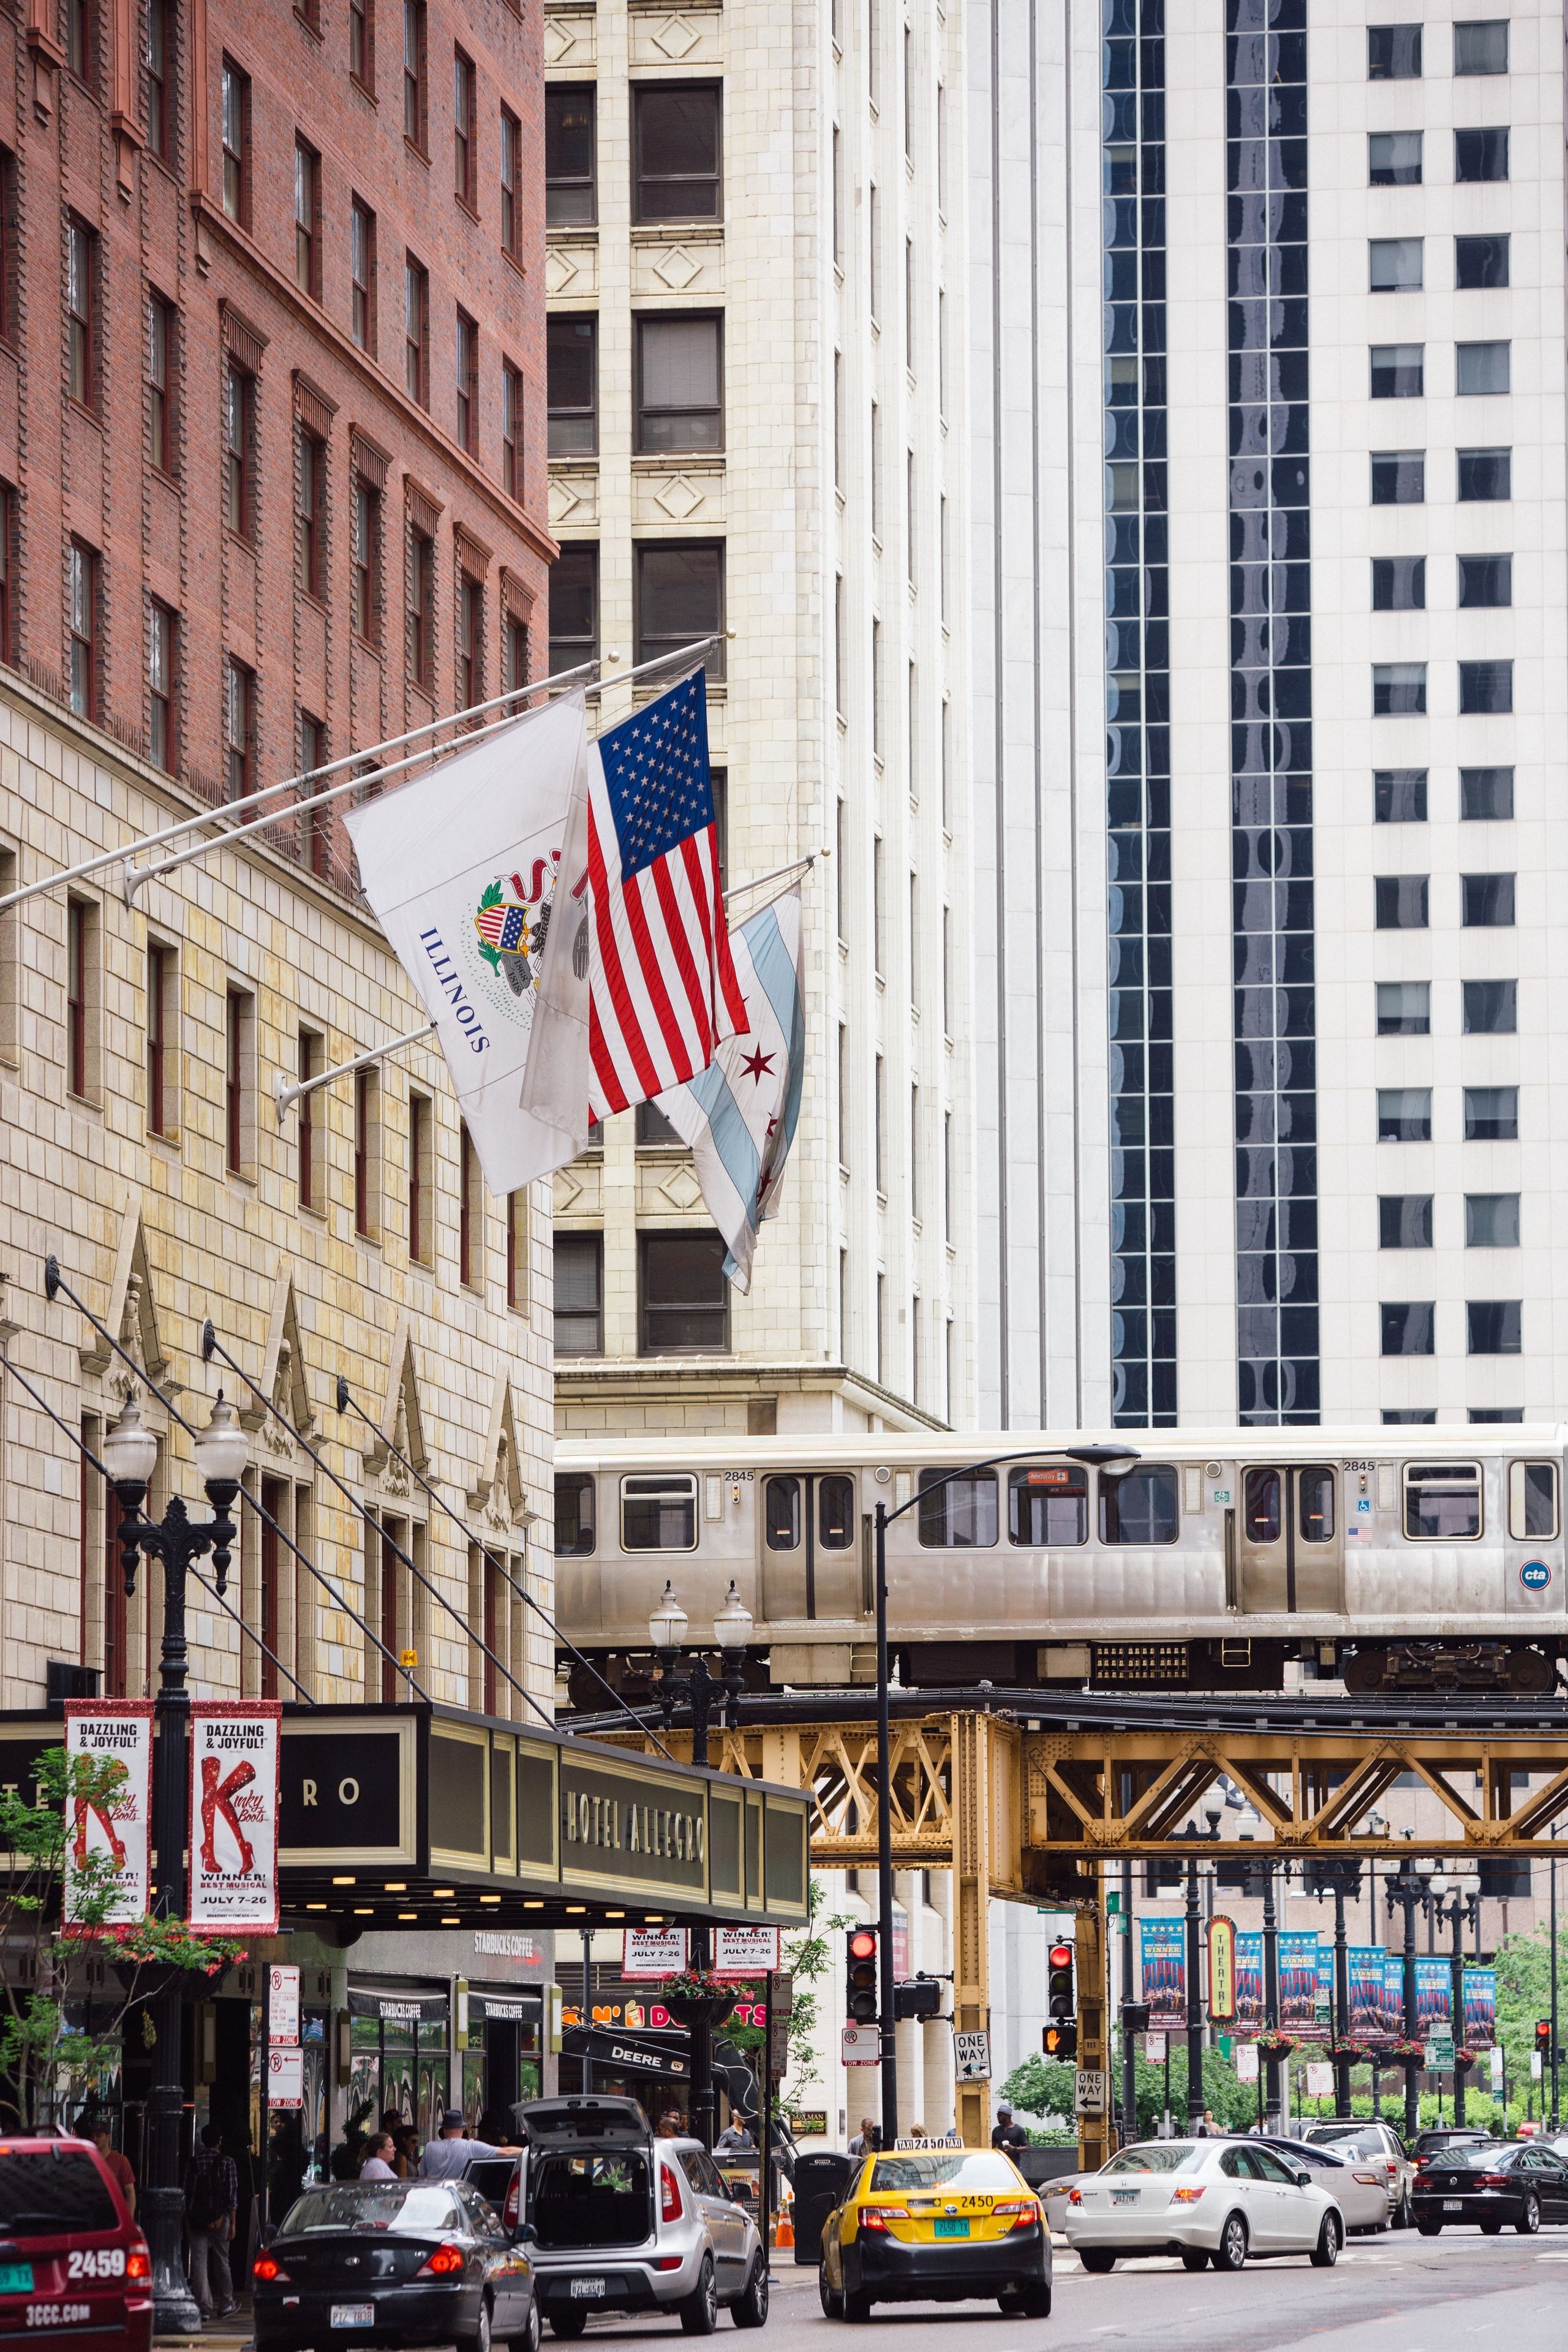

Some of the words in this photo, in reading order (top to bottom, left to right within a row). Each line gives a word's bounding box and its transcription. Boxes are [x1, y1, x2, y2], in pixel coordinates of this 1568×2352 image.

[514, 959, 528, 981] 1868
[508, 971, 522, 992] 1818
[419, 926, 491, 1054] ILLINOIS
[1344, 1461, 1374, 1471] 2845
[725, 1471, 754, 1481] 2845
[1525, 1569, 1546, 1580] cta
[80, 1736, 88, 1747] &
[206, 1738, 214, 1749] &
[110, 1807, 141, 1822] Boots
[238, 1807, 269, 1823] Boots
[567, 1791, 620, 1849] HOTEL
[630, 1803, 704, 1864] ALLEGRO
[474, 1931, 510, 1956] STARBUCKS
[511, 1936, 533, 1958] COFFEE
[1143, 1960, 1185, 1989] PIPPIN
[1280, 1970, 1317, 1994] PIPPIN
[1351, 1982, 1384, 2007] PIPPIN
[380, 2001, 405, 2018] STARBUCKS
[405, 2003, 421, 2018] COFFEE
[485, 2002, 508, 2018] STARBUCKS
[509, 2004, 522, 2018] COFFEE
[1417, 1991, 1449, 2015] PIPPIN
[959, 2035, 985, 2048] ONE
[611, 2046, 662, 2068] DEERE
[959, 2048, 986, 2062] WAY
[1079, 2073, 1101, 2084] ONE
[1078, 2085, 1101, 2095] WAY
[270, 2098, 281, 2107] TOW
[284, 2098, 297, 2107] ZONE
[898, 2139, 913, 2150] TAXI
[946, 2138, 962, 2148] TAXI
[961, 2195, 993, 2208] 2450
[939, 2223, 956, 2233] 2450
[960, 2223, 968, 2233] TX
[68, 2248, 125, 2278] 2459
[26, 2304, 90, 2327] 3CCC.COM
